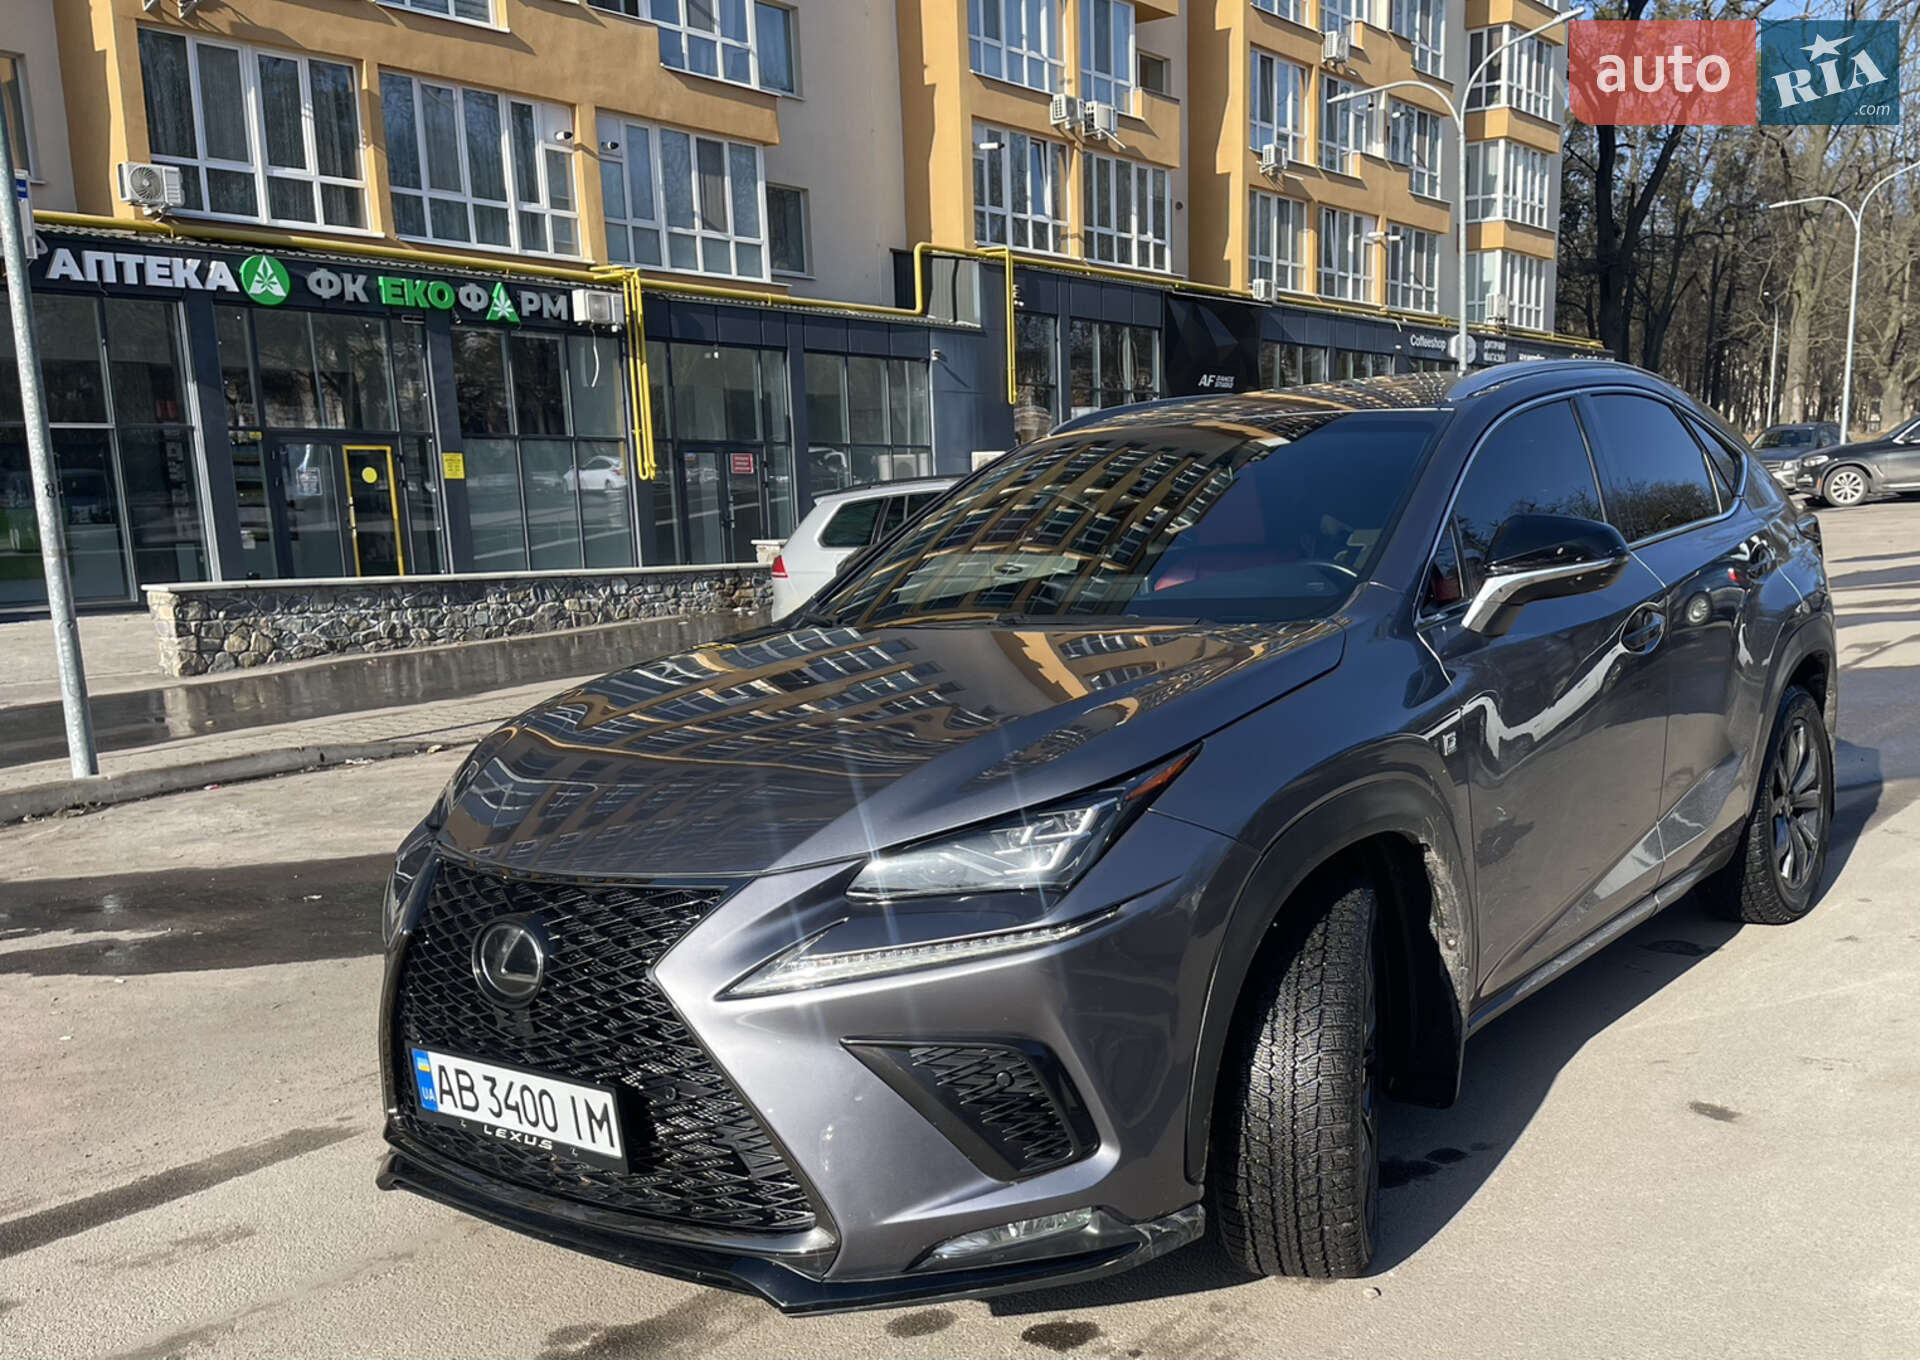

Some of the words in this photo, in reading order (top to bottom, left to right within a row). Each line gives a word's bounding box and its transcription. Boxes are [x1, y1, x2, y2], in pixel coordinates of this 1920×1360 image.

[46, 248, 240, 293] АПТЕКА
[306, 267, 370, 303] ФК
[1410, 334, 1447, 351] Coffeeshop
[1198, 374, 1216, 387] AF
[421, 1087, 436, 1101] UA
[438, 1064, 479, 1112] AB
[482, 1074, 558, 1133] 3400
[570, 1095, 615, 1149] IM
[483, 1124, 552, 1150] LEXUS
